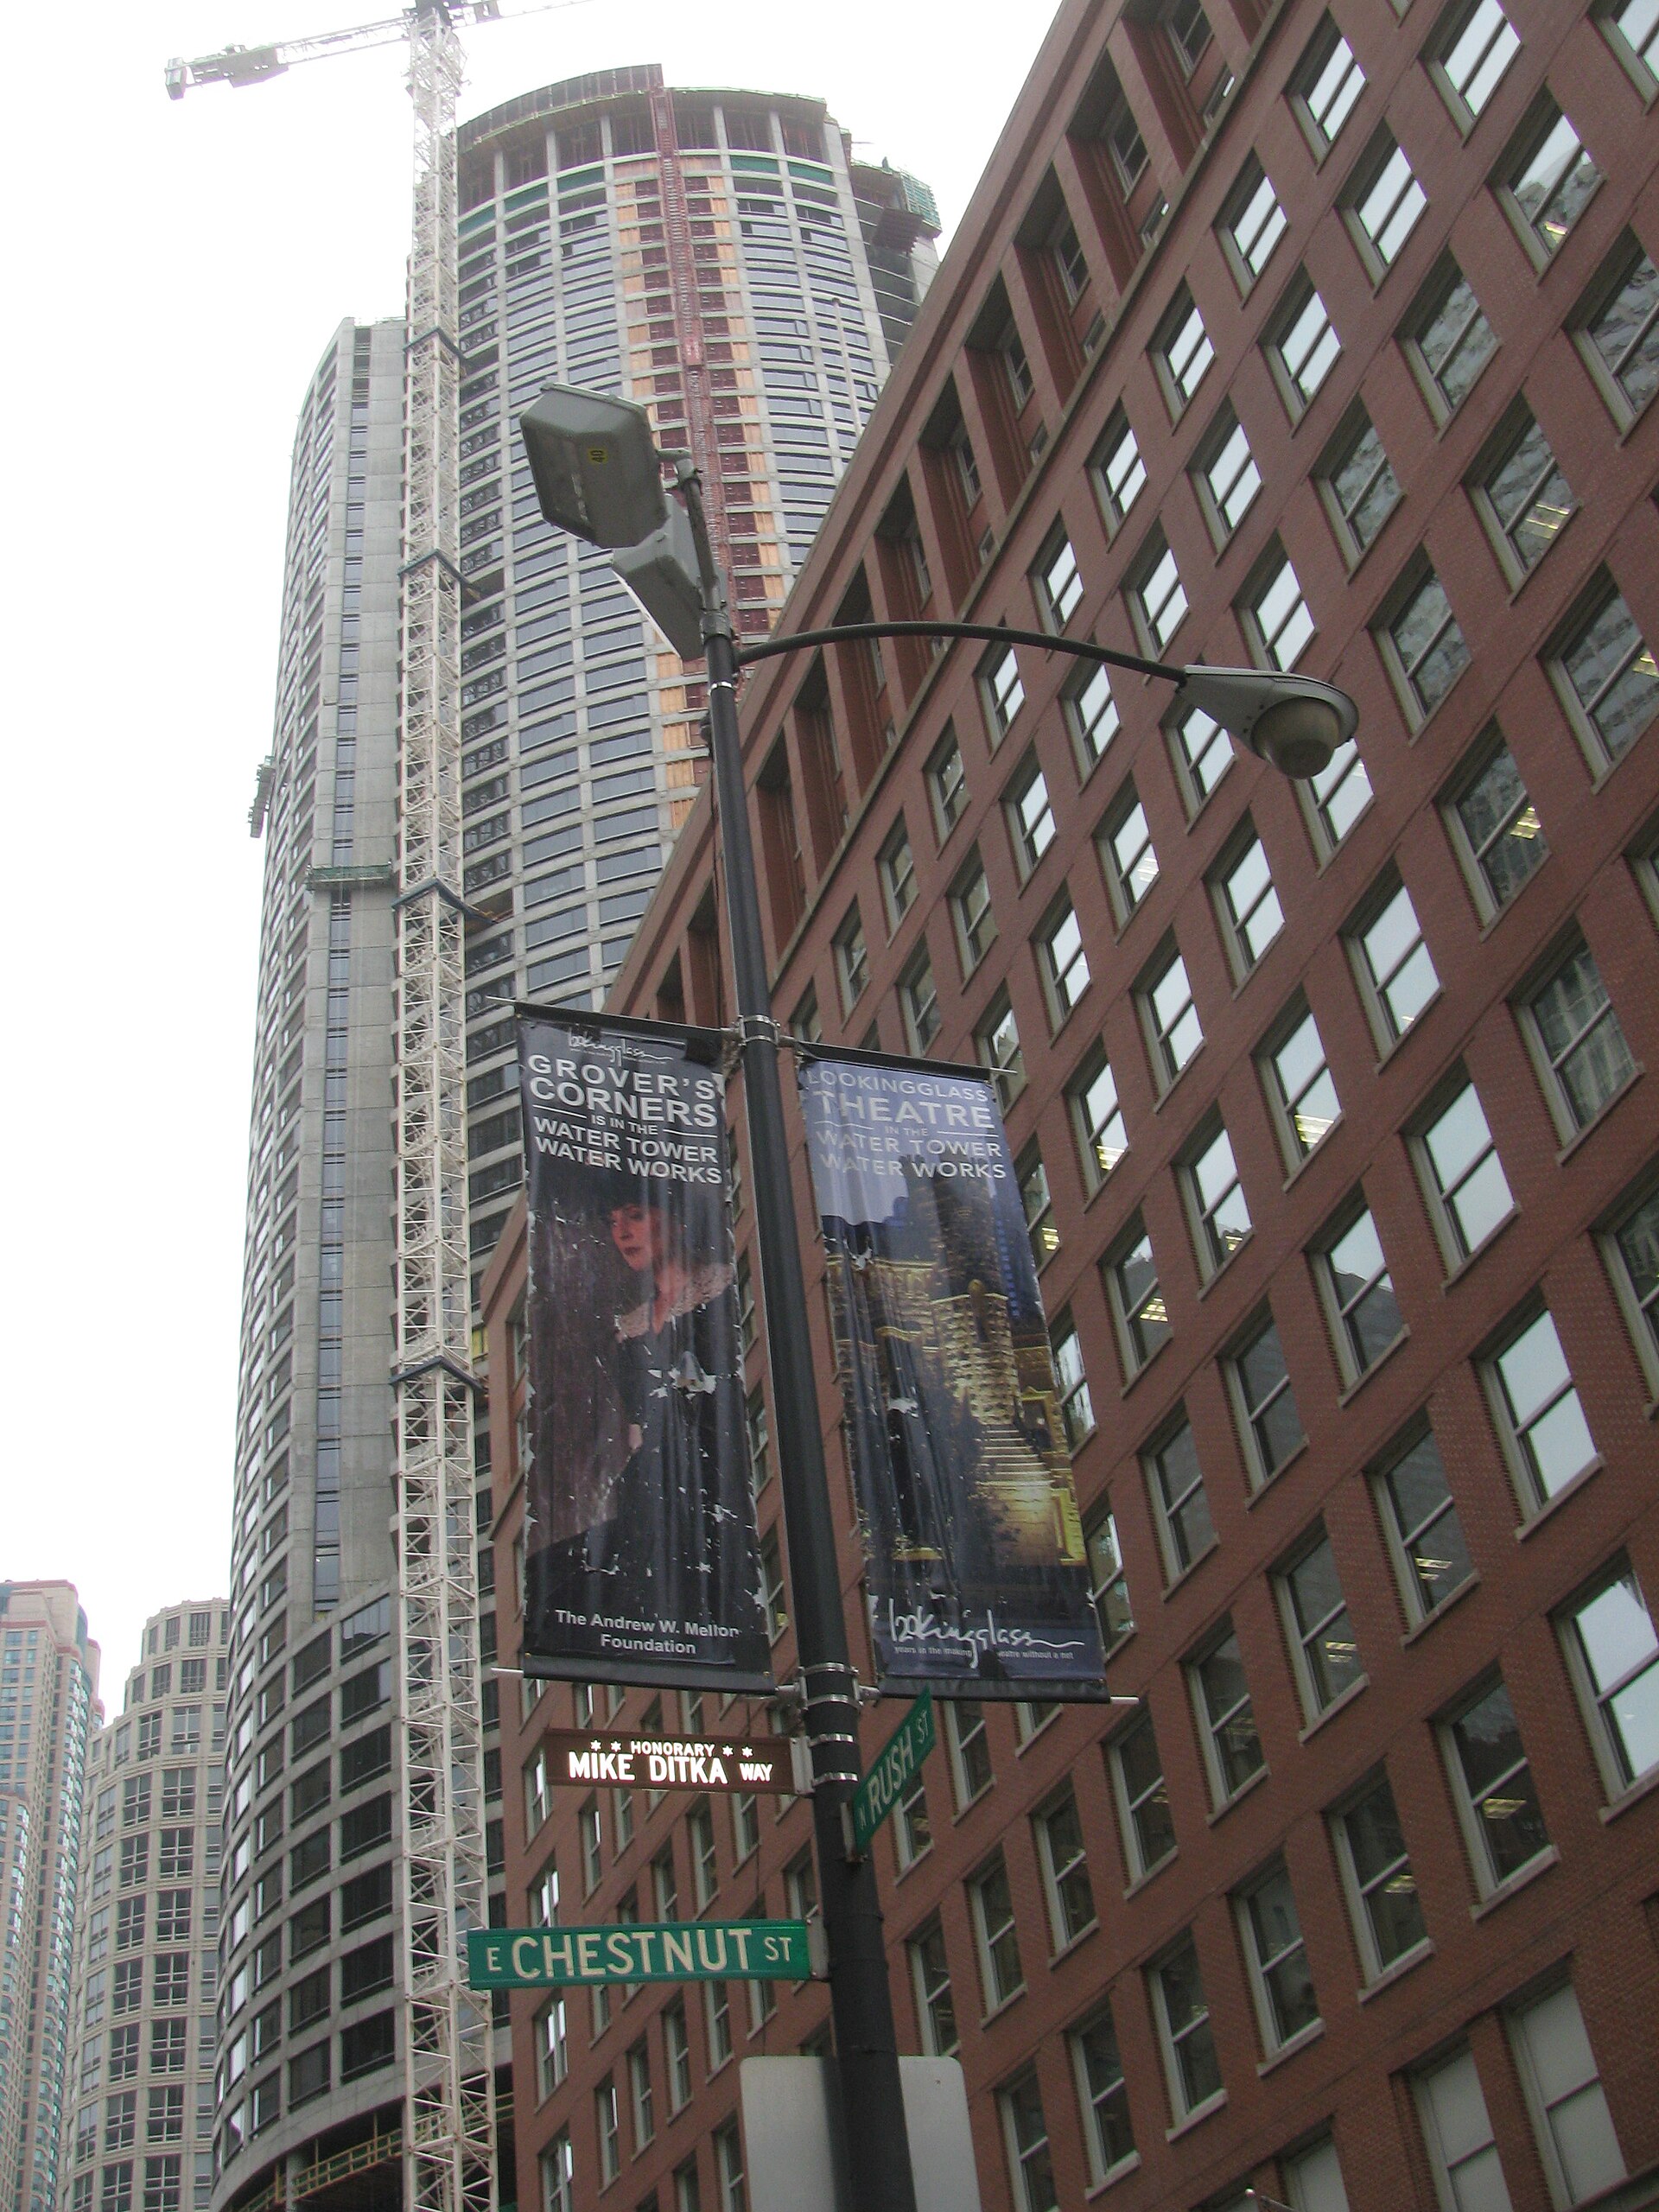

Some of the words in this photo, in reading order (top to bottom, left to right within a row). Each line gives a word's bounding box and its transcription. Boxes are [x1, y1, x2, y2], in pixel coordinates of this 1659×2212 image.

[528, 1054, 716, 1100] GROVER'S
[807, 1070, 988, 1102] LOOKINGGLASS
[530, 1077, 717, 1128] CORNERS
[813, 1090, 995, 1129] THEATRE
[533, 1116, 621, 1150] WATER
[626, 1137, 718, 1163] TOWER
[592, 1115, 606, 1125] IS
[610, 1117, 625, 1129] IN
[628, 1122, 658, 1135] THE
[904, 1127, 928, 1136] THE
[816, 1129, 899, 1154] WATER
[910, 1140, 1003, 1158] TOWER
[536, 1136, 622, 1171] WATER
[626, 1158, 722, 1184] WORKS
[821, 1154, 904, 1176] WATER
[911, 1161, 1007, 1179] WORKS
[555, 1609, 586, 1625] The
[590, 1614, 656, 1632] Andrew
[658, 1619, 680, 1634] W.
[601, 1633, 696, 1655] Foundation
[631, 1740, 715, 1758] HONORARY
[568, 1751, 635, 1781] MIKE
[649, 1752, 728, 1784] DITKA
[740, 1762, 773, 1782] WAY
[868, 1726, 914, 1825] RUSH
[917, 1709, 929, 1744] ST
[487, 1946, 502, 1971] E
[511, 1927, 753, 1980] CHESTNUT
[764, 1936, 792, 1962] ST
